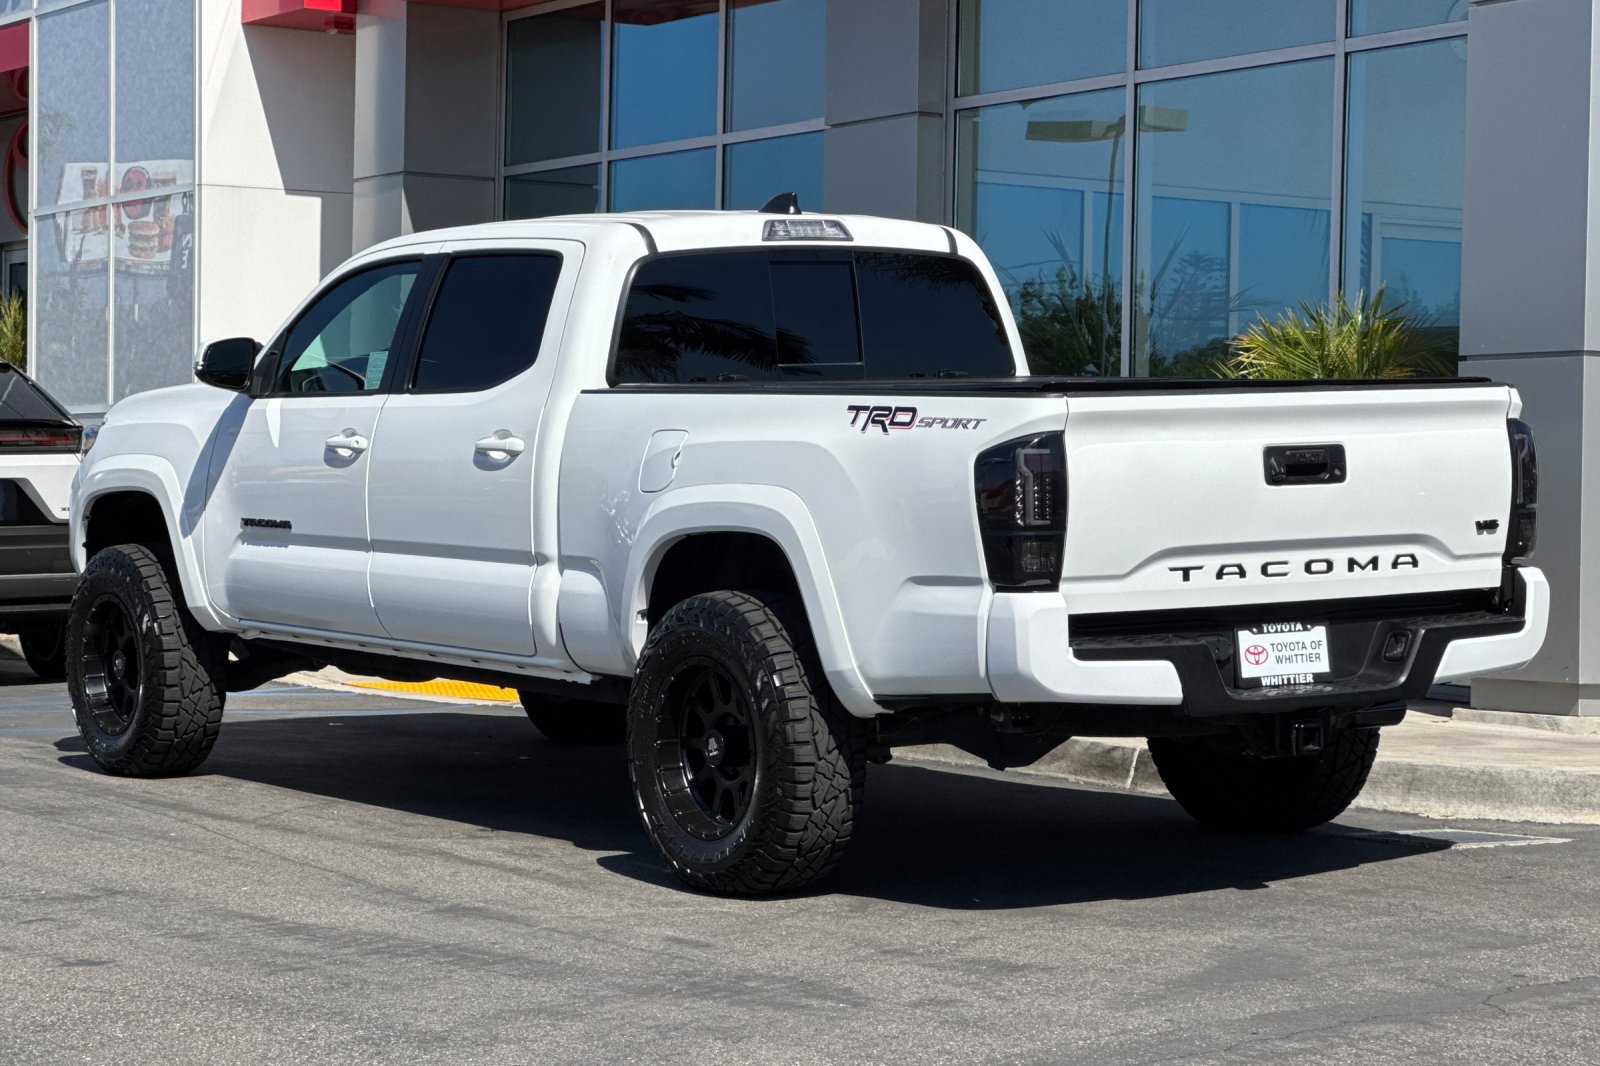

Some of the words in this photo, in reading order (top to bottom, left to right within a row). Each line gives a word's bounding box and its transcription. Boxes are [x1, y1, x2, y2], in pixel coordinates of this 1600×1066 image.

[847, 405, 918, 435] TRD
[915, 416, 988, 430] SPORT
[241, 517, 292, 529] TACOMA
[1168, 553, 1419, 582] TACOMA
[1262, 622, 1303, 633] TOYOTA
[1270, 641, 1307, 653] TOYOTA
[1310, 640, 1323, 651] OF
[1275, 652, 1321, 665] WHITTIER
[1261, 673, 1314, 687] WHITTIER
